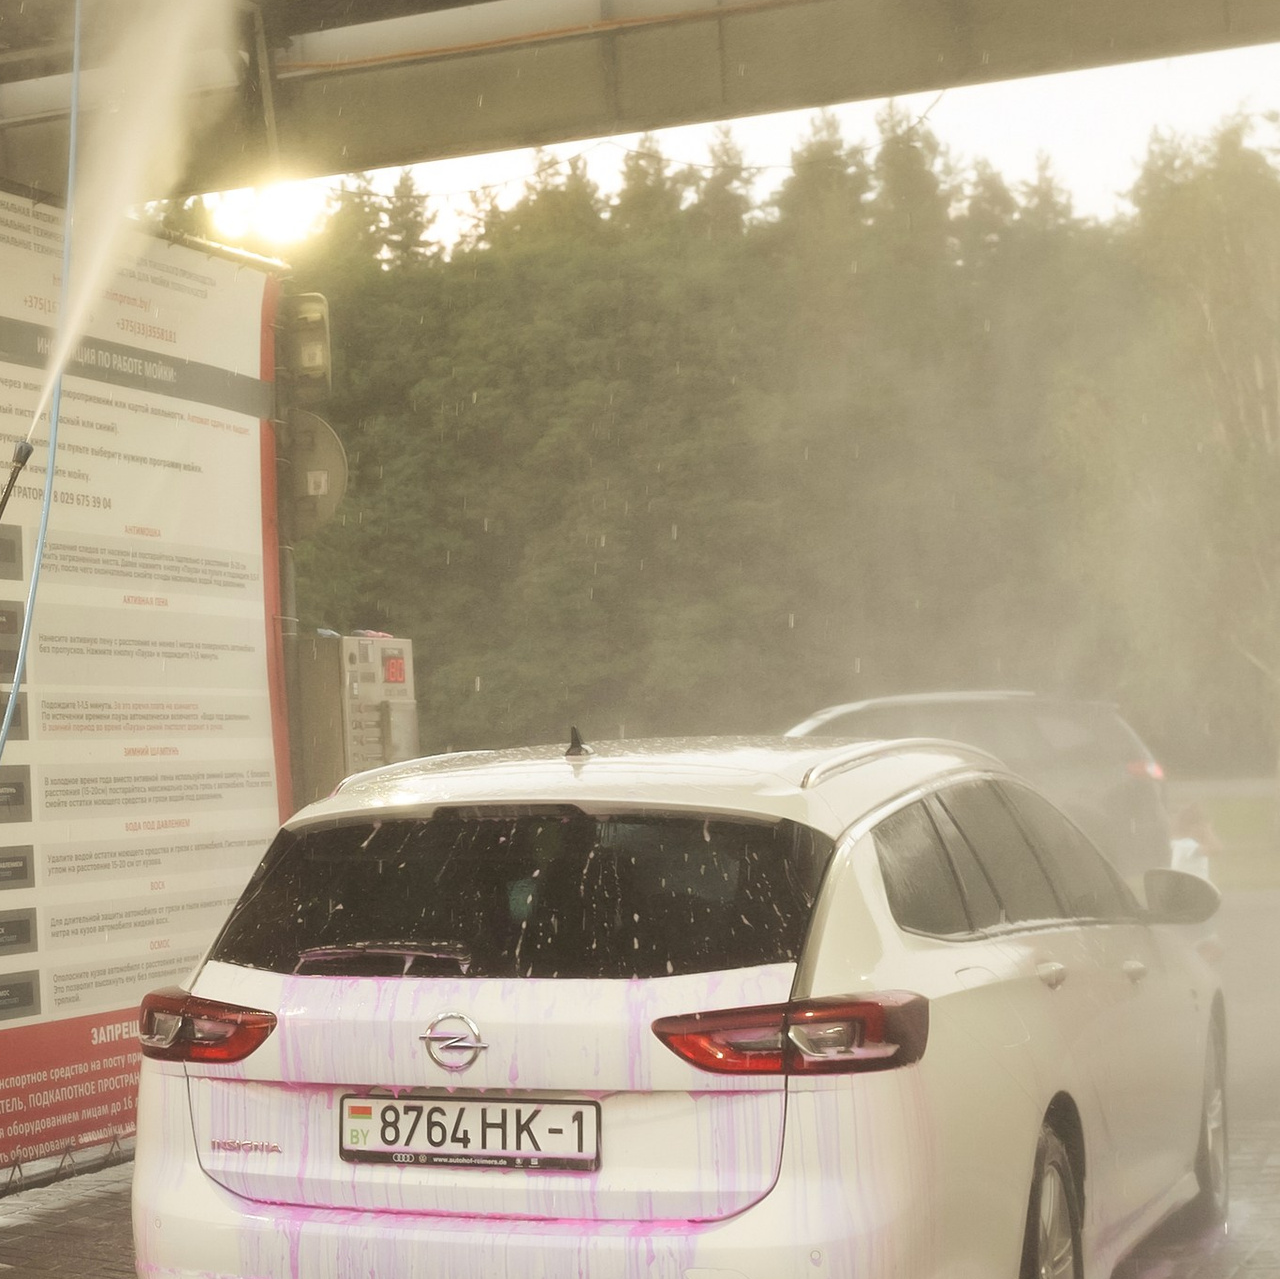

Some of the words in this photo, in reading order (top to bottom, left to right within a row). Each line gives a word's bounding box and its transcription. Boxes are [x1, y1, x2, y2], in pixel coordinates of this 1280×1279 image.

[98, 350, 111, 369] ПО
[112, 353, 143, 376] РАБОТЕ
[144, 360, 177, 383] МОЙКИ:
[0, 377, 22, 393] через
[53, 491, 58, 503] 8
[59, 492, 75, 506] 029
[76, 494, 91, 508] 675
[92, 495, 102, 509] 39
[102, 496, 112, 510] 04
[125, 821, 141, 833] ВОДА
[142, 819, 155, 831] ПОД
[150, 880, 166, 891] ВОСК
[149, 939, 170, 951] ОСМОС
[50, 1063, 88, 1084] средство
[90, 1060, 101, 1072] на
[103, 1055, 125, 1072] посту
[29, 1083, 96, 1110] ПОДКАПОТНОЕ
[7, 1112, 80, 1139] оборудованием
[81, 1106, 109, 1124] лицам
[111, 1103, 122, 1119] до
[123, 1097, 133, 1112] 16
[10, 1135, 77, 1161] оборудование
[78, 1125, 124, 1145] автомойки
[350, 1128, 370, 1146] BY
